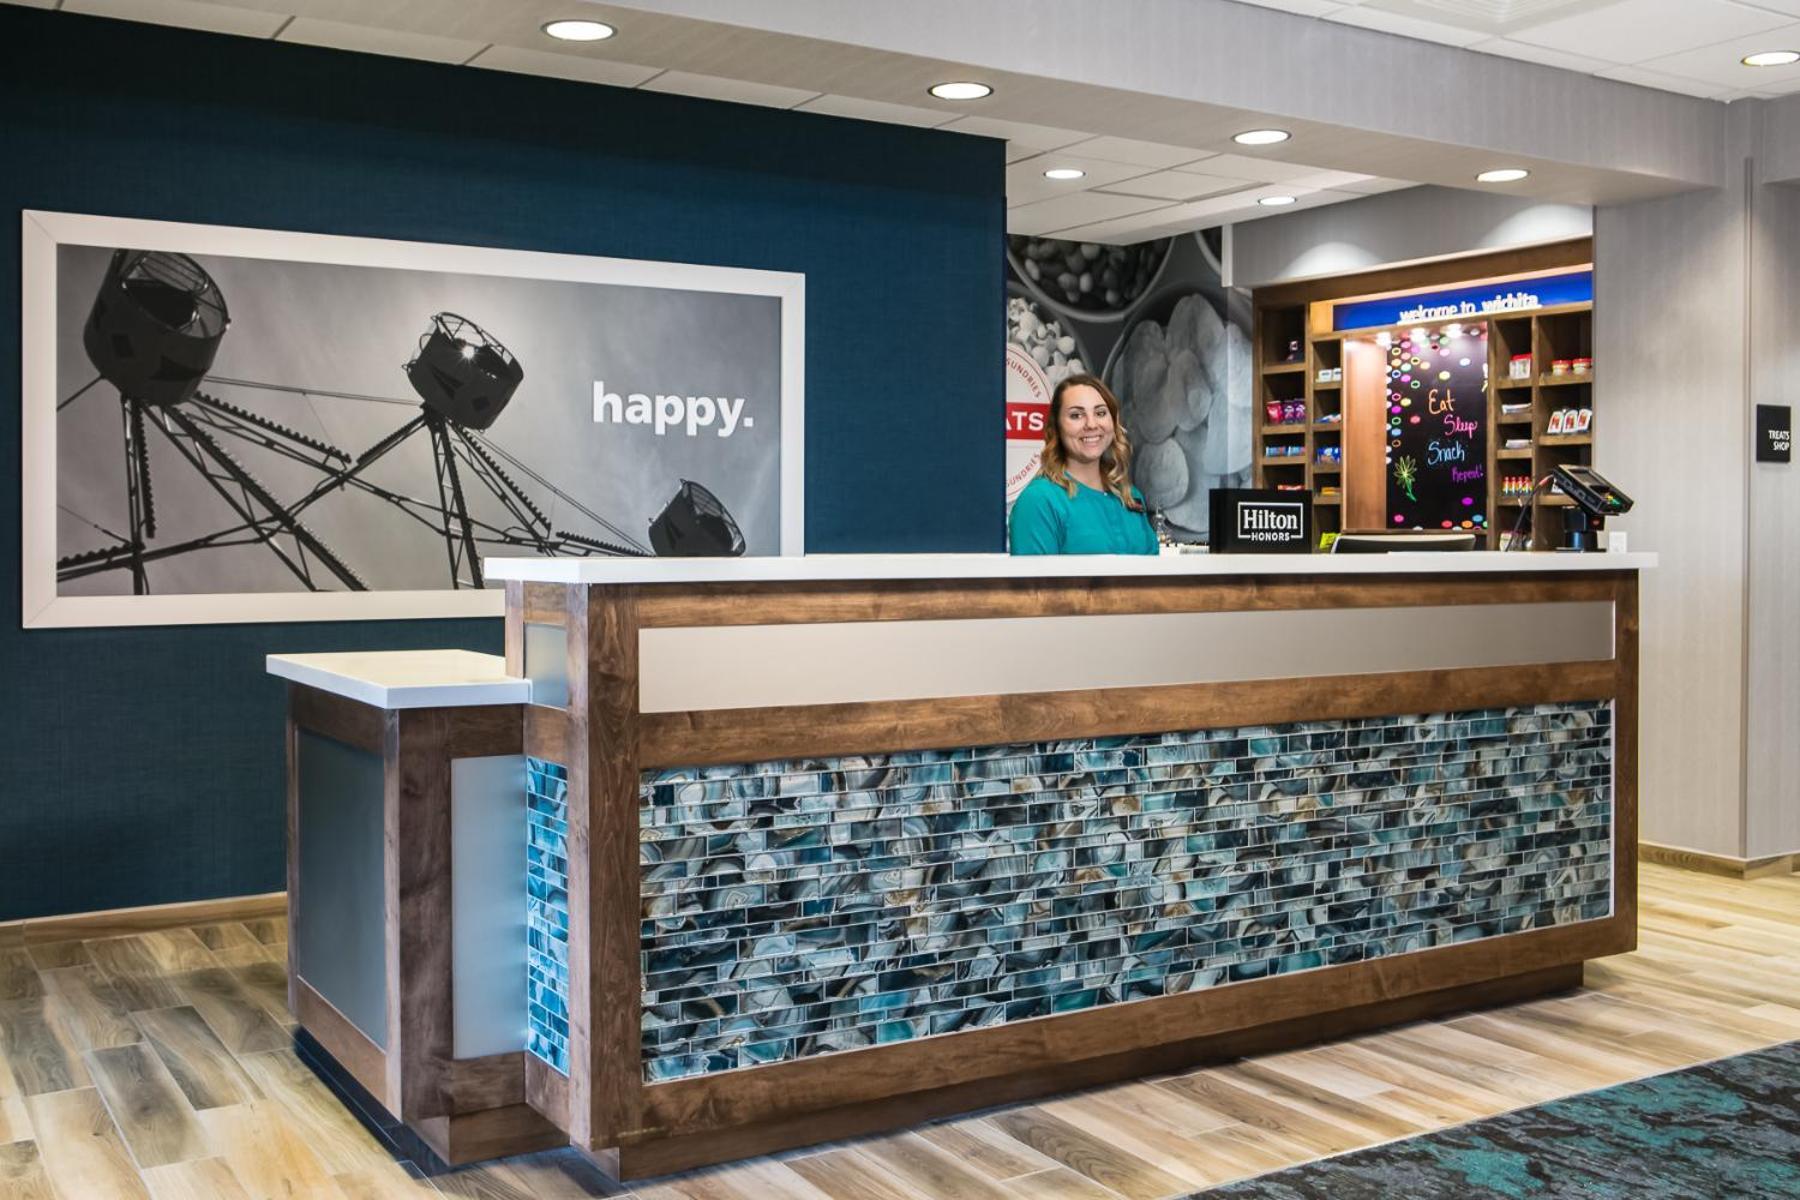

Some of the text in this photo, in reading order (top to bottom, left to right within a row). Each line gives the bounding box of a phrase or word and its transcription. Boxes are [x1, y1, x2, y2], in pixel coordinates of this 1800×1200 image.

[1400, 291, 1539, 321] welcome to wichita
[592, 380, 755, 438] happy.
[1428, 388, 1456, 415] Eat
[1443, 413, 1478, 440] Sleep
[1768, 430, 1790, 440] TREATS
[1427, 440, 1465, 465] Snack
[1773, 441, 1790, 451] SHOP
[1243, 509, 1298, 530] Hilton
[1251, 532, 1290, 541] HONORS
